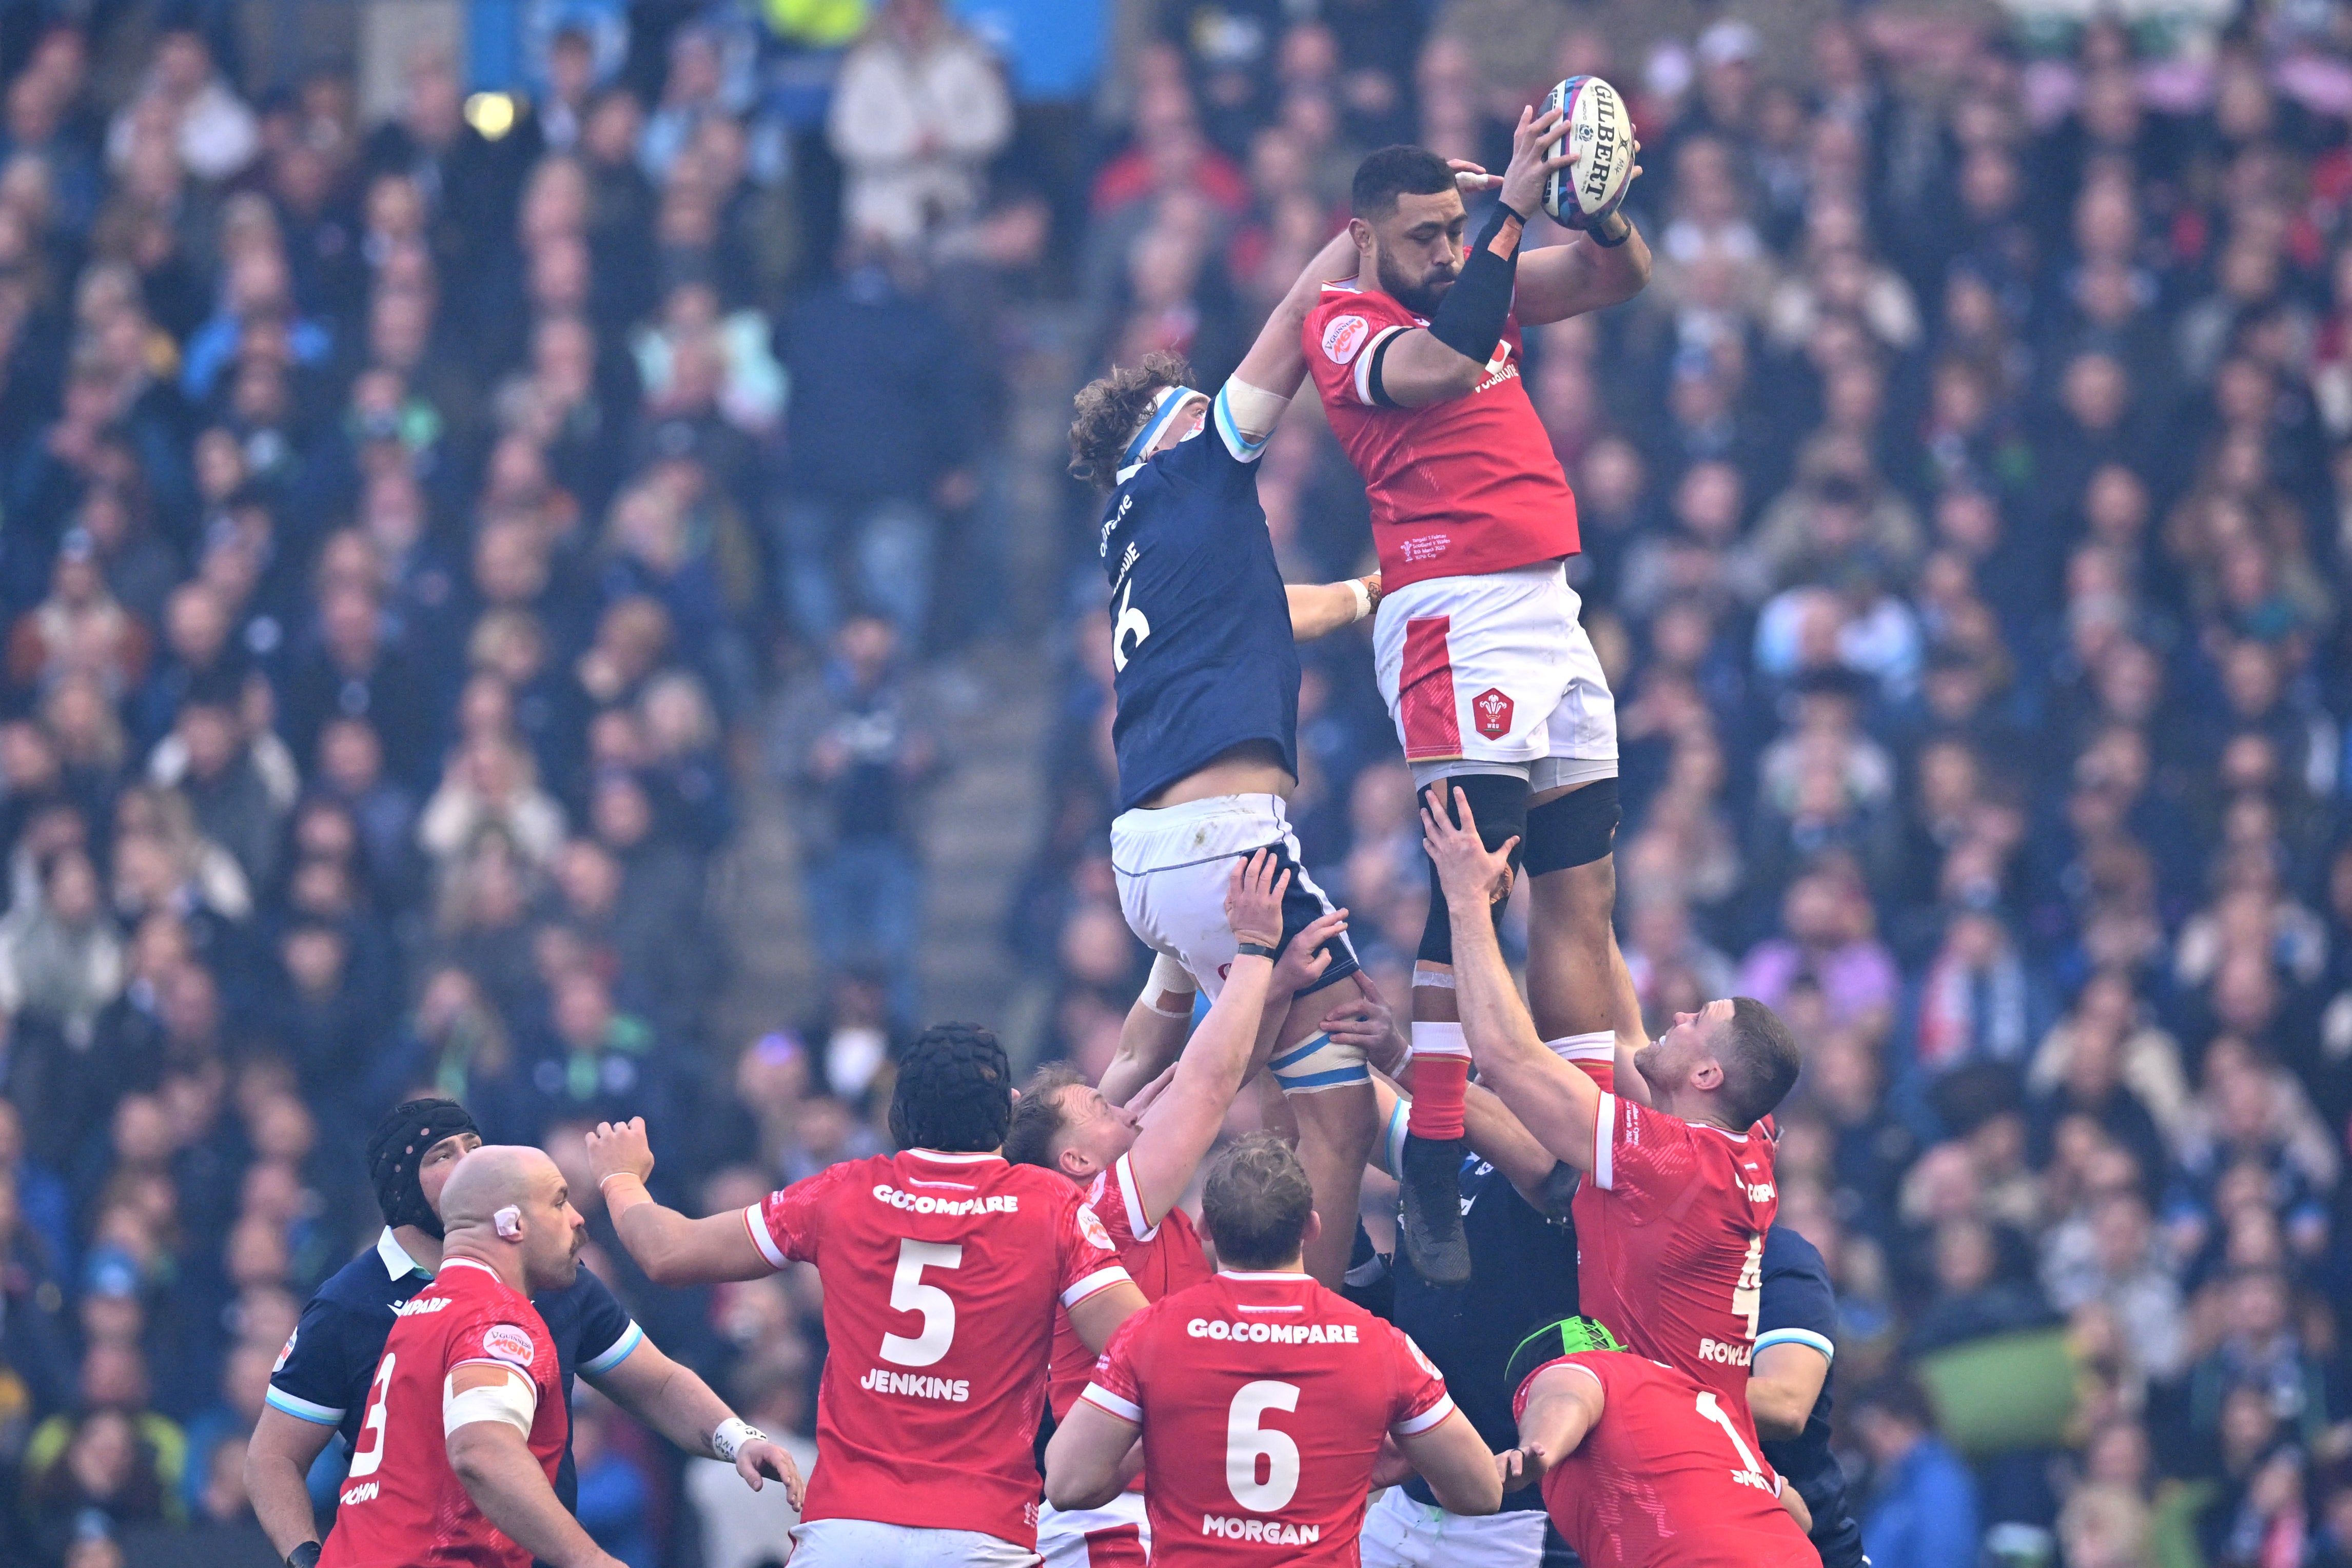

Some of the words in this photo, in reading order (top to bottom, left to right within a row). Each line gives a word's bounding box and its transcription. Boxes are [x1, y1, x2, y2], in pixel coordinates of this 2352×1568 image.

[1586, 85, 1614, 201] GILBERT
[1330, 318, 1356, 343] GUINNESS
[879, 1238, 963, 1366] 5
[1187, 1318, 1359, 1344] GO.COMPARE
[499, 1333, 532, 1349] GUINNESS
[860, 1368, 970, 1402] JENKINS
[349, 1353, 396, 1477] 3
[1696, 1390, 1762, 1474] 1
[1226, 1380, 1300, 1512] 6
[1202, 1514, 1319, 1545] MORGAN
